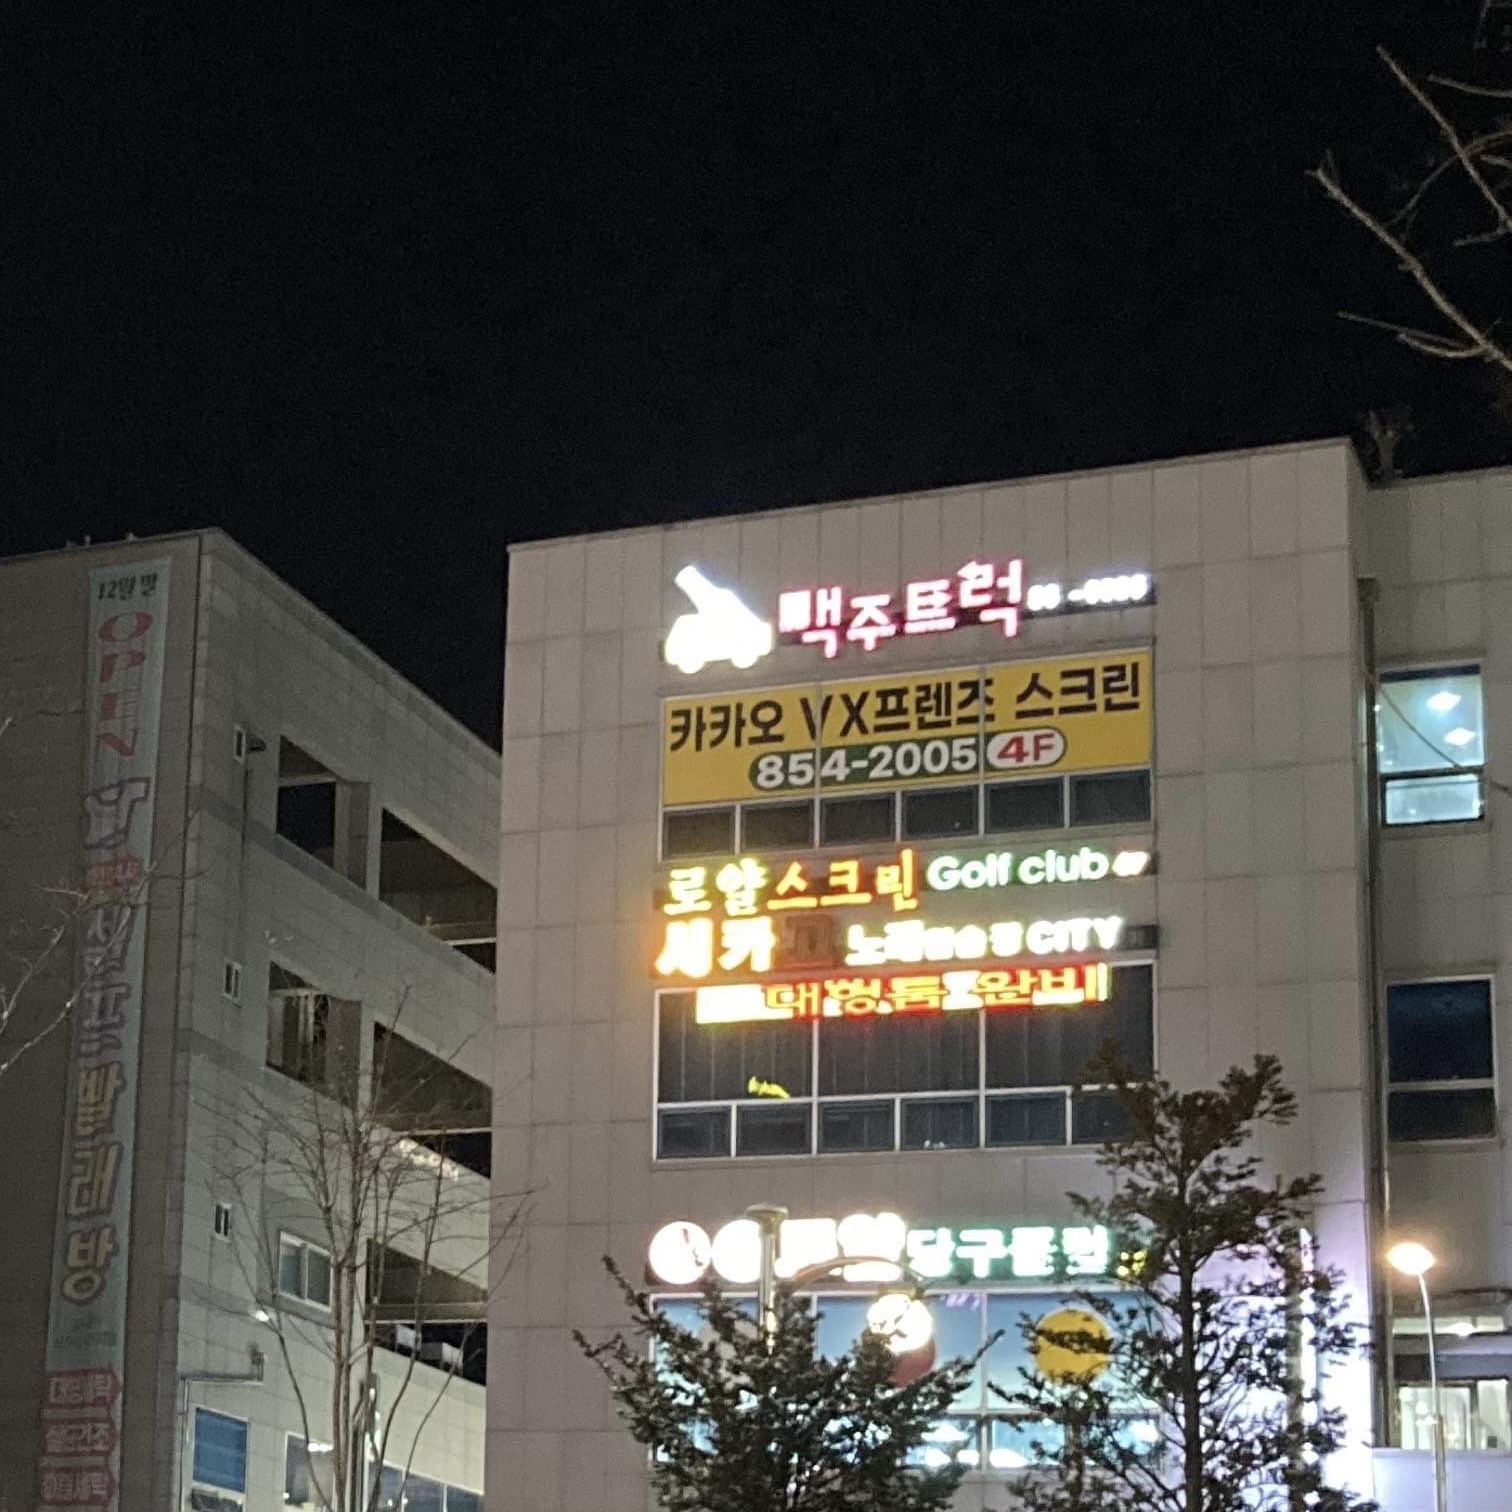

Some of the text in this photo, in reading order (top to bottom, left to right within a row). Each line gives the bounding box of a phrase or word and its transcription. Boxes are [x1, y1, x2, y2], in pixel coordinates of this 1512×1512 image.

[669, 699, 785, 753] 카카오
[1015, 661, 1140, 720] 스크린
[755, 732, 1055, 789] 854-2005 4F
[926, 851, 1013, 891] Golf
[1018, 846, 1110, 885] club
[1026, 915, 1123, 955] CITY
